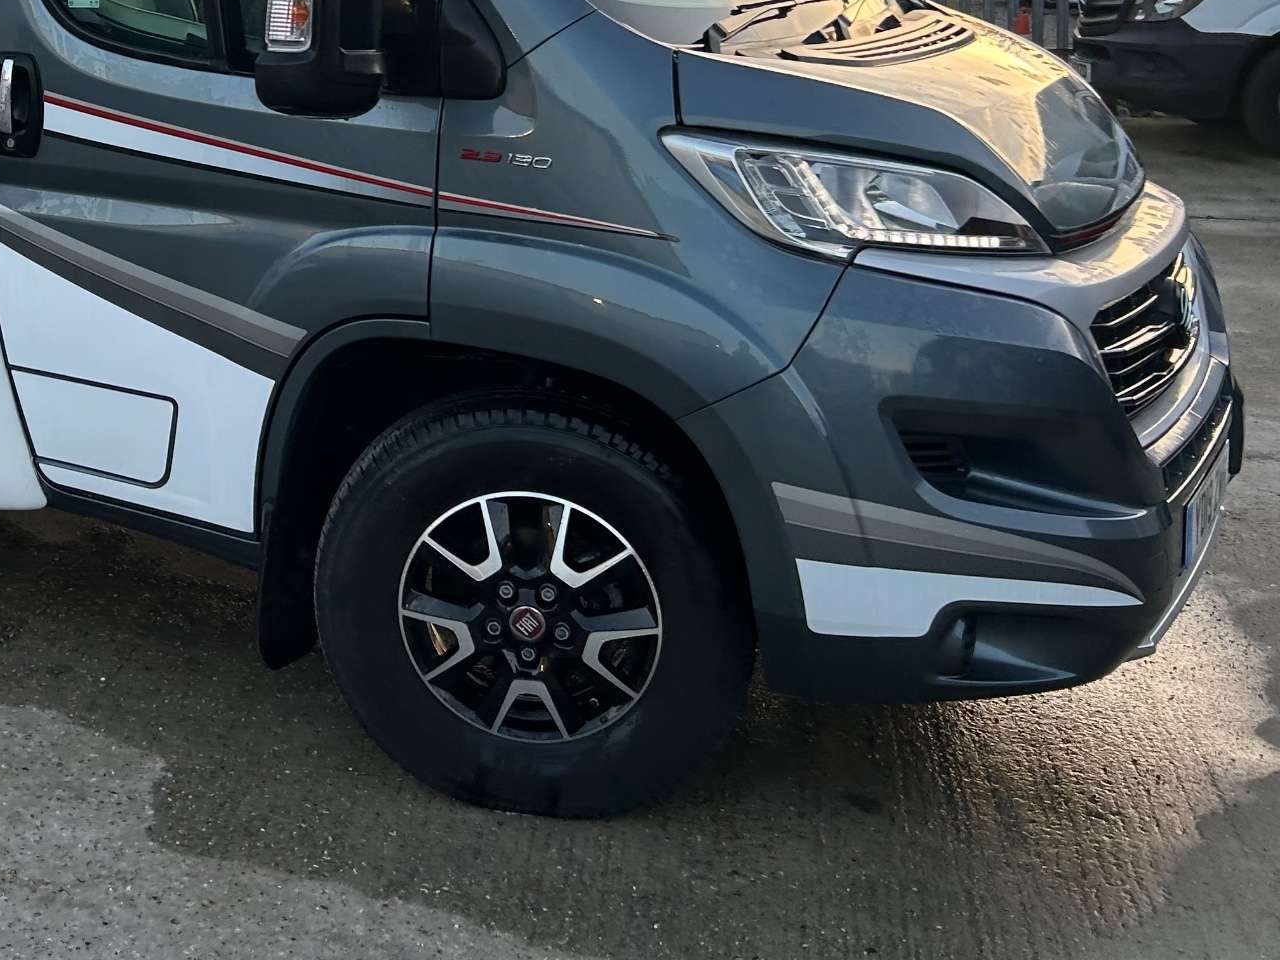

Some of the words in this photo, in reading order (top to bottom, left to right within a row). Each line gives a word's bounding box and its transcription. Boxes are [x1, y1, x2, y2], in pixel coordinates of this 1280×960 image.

[460, 148, 502, 163] 2.3
[506, 152, 553, 169] 130
[515, 612, 540, 637] FIAT
